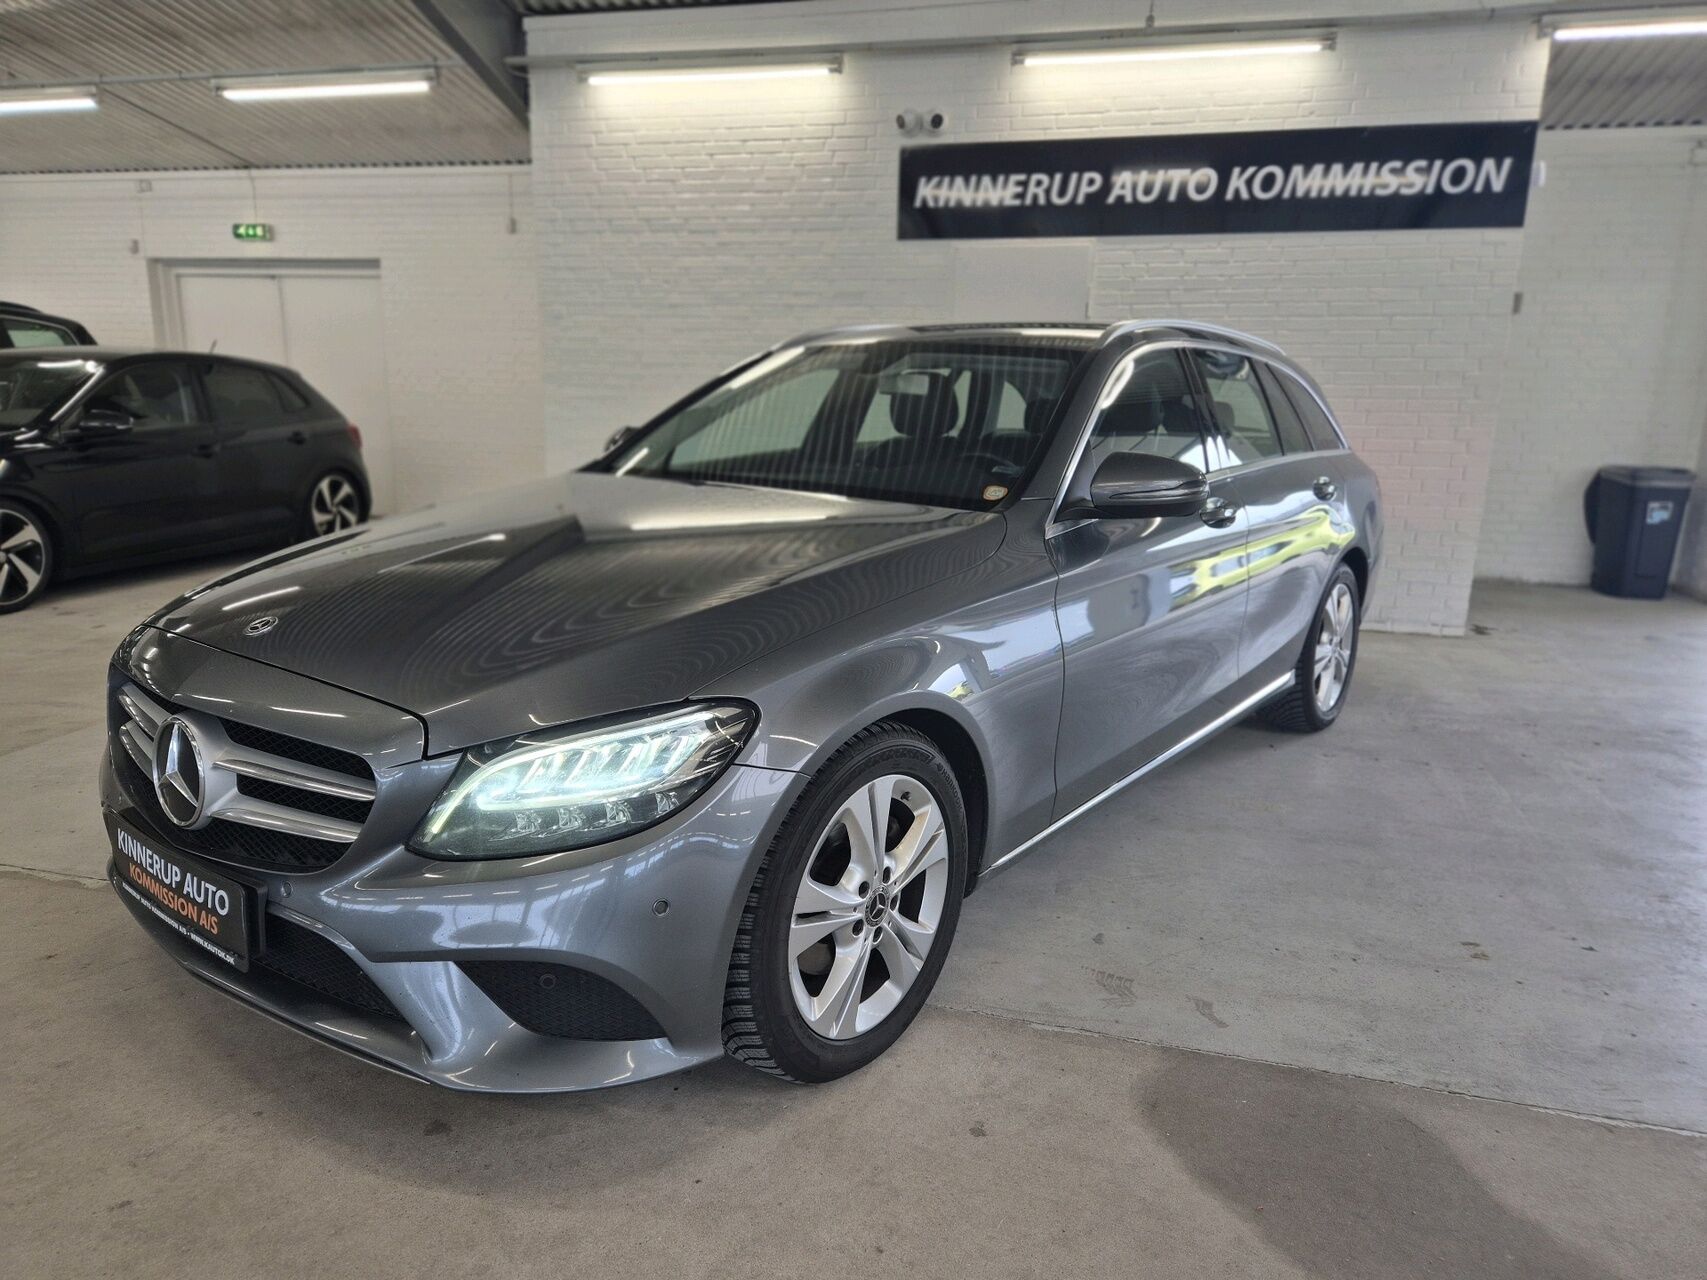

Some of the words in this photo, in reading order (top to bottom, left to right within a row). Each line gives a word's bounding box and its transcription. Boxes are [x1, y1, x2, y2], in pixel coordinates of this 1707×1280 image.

[913, 171, 1103, 209] KINNERUP
[1105, 166, 1219, 205] AUTO
[1225, 156, 1514, 201] KOMMISSION
[117, 828, 181, 888] KINNERUP
[183, 872, 229, 916] AUTO
[129, 863, 198, 922] KOMMISSION
[199, 911, 218, 935] A/S
